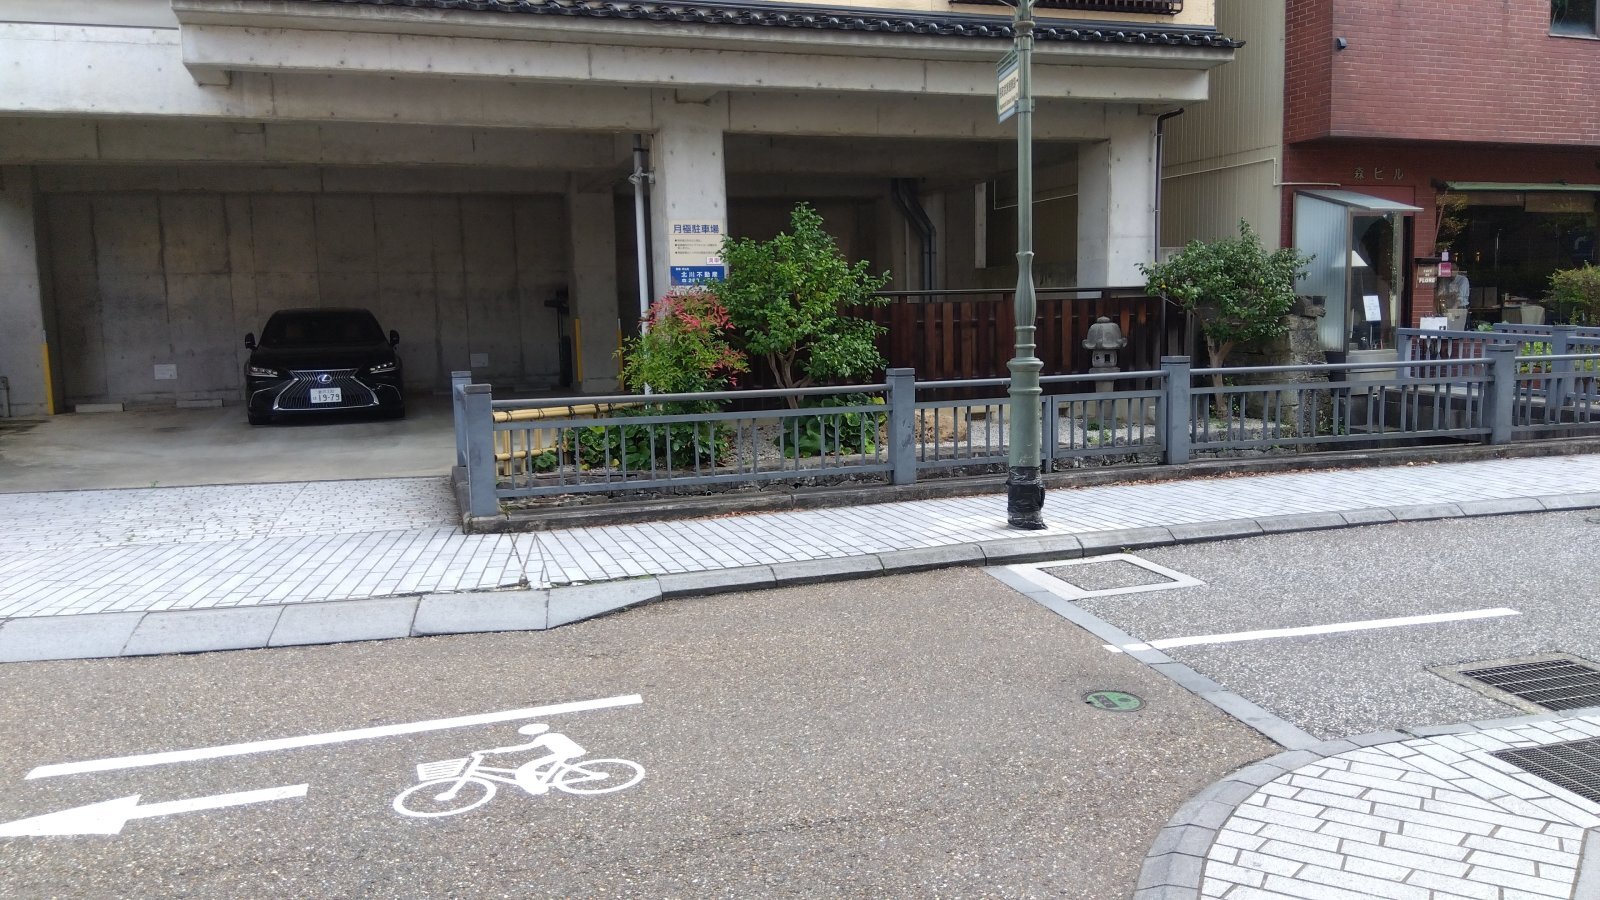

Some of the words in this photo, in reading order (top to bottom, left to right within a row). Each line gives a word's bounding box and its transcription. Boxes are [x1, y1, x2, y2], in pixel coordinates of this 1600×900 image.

[674, 224, 719, 234] 月極駐車場
